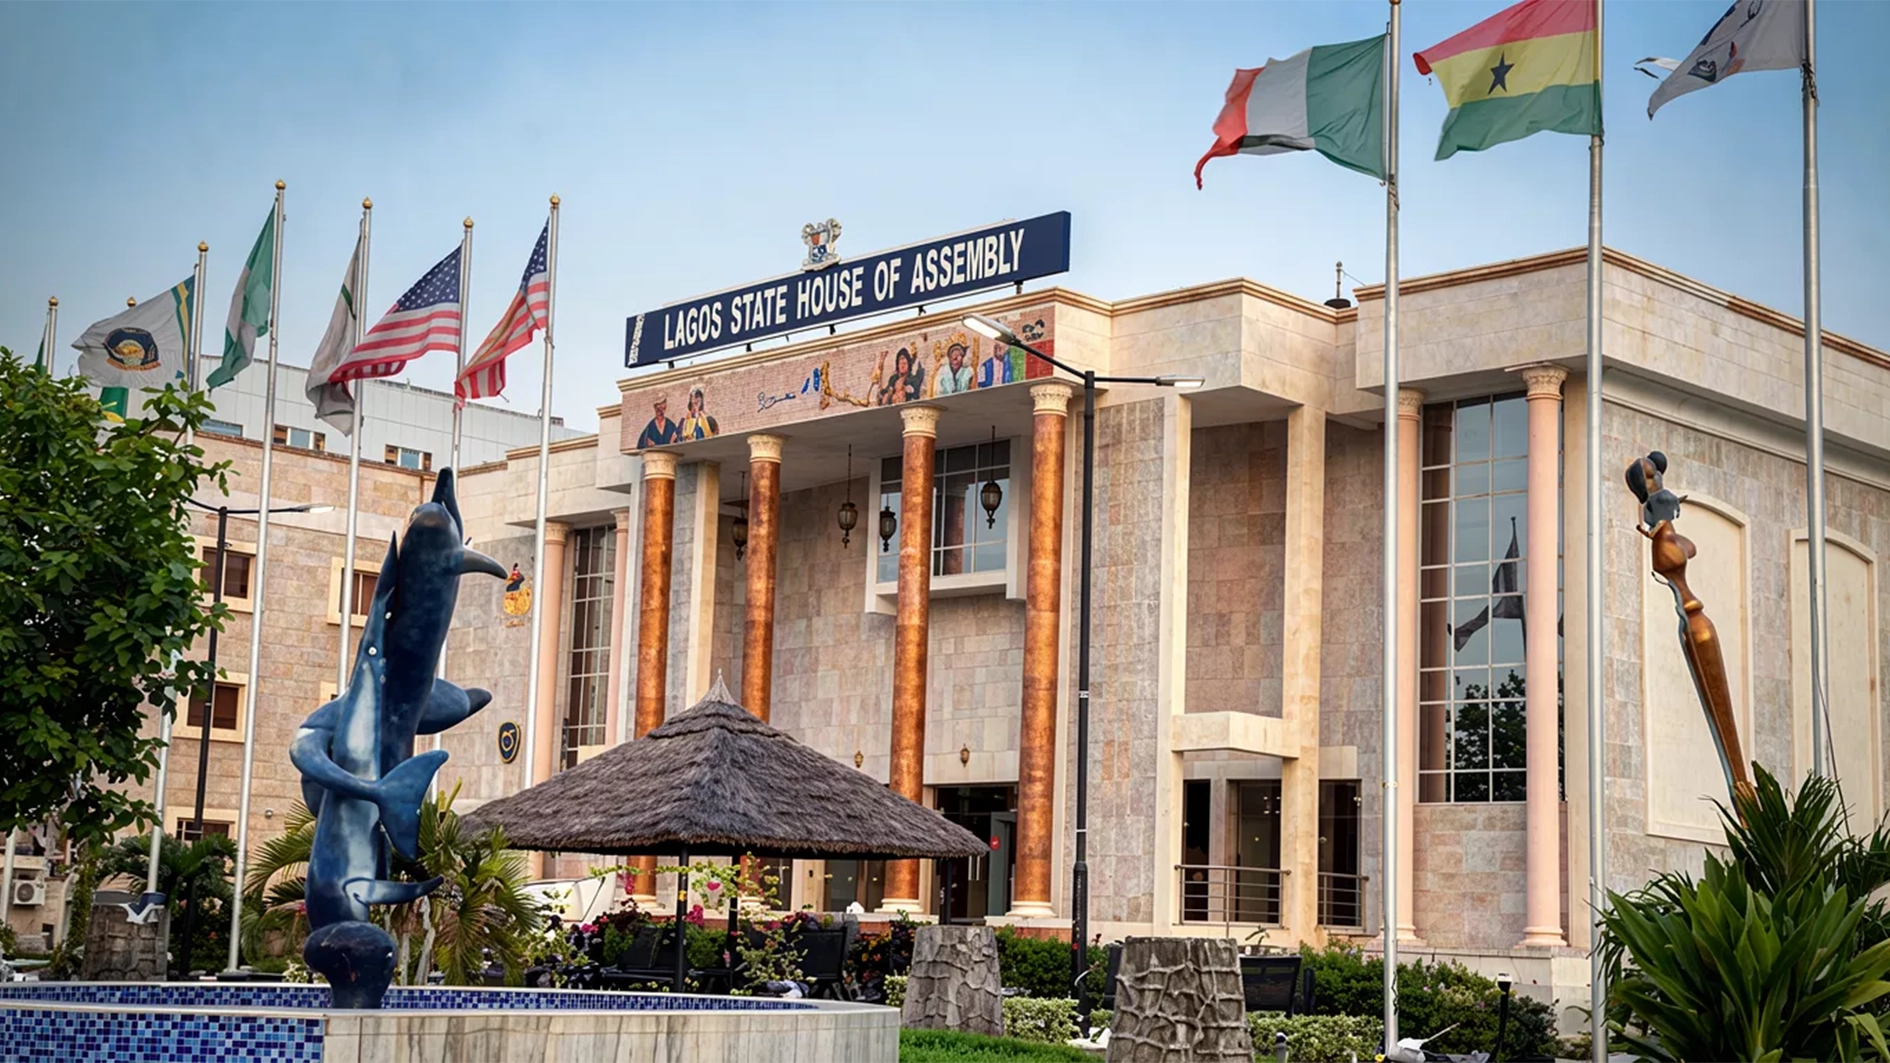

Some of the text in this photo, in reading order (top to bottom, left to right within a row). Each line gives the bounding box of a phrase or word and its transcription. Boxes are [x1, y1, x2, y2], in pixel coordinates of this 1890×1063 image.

[664, 301, 722, 350] LAGOS
[730, 285, 788, 334] STATE
[796, 266, 864, 320] HOUSE
[873, 257, 902, 302] OF
[910, 228, 1025, 294] ASSEMBLY
